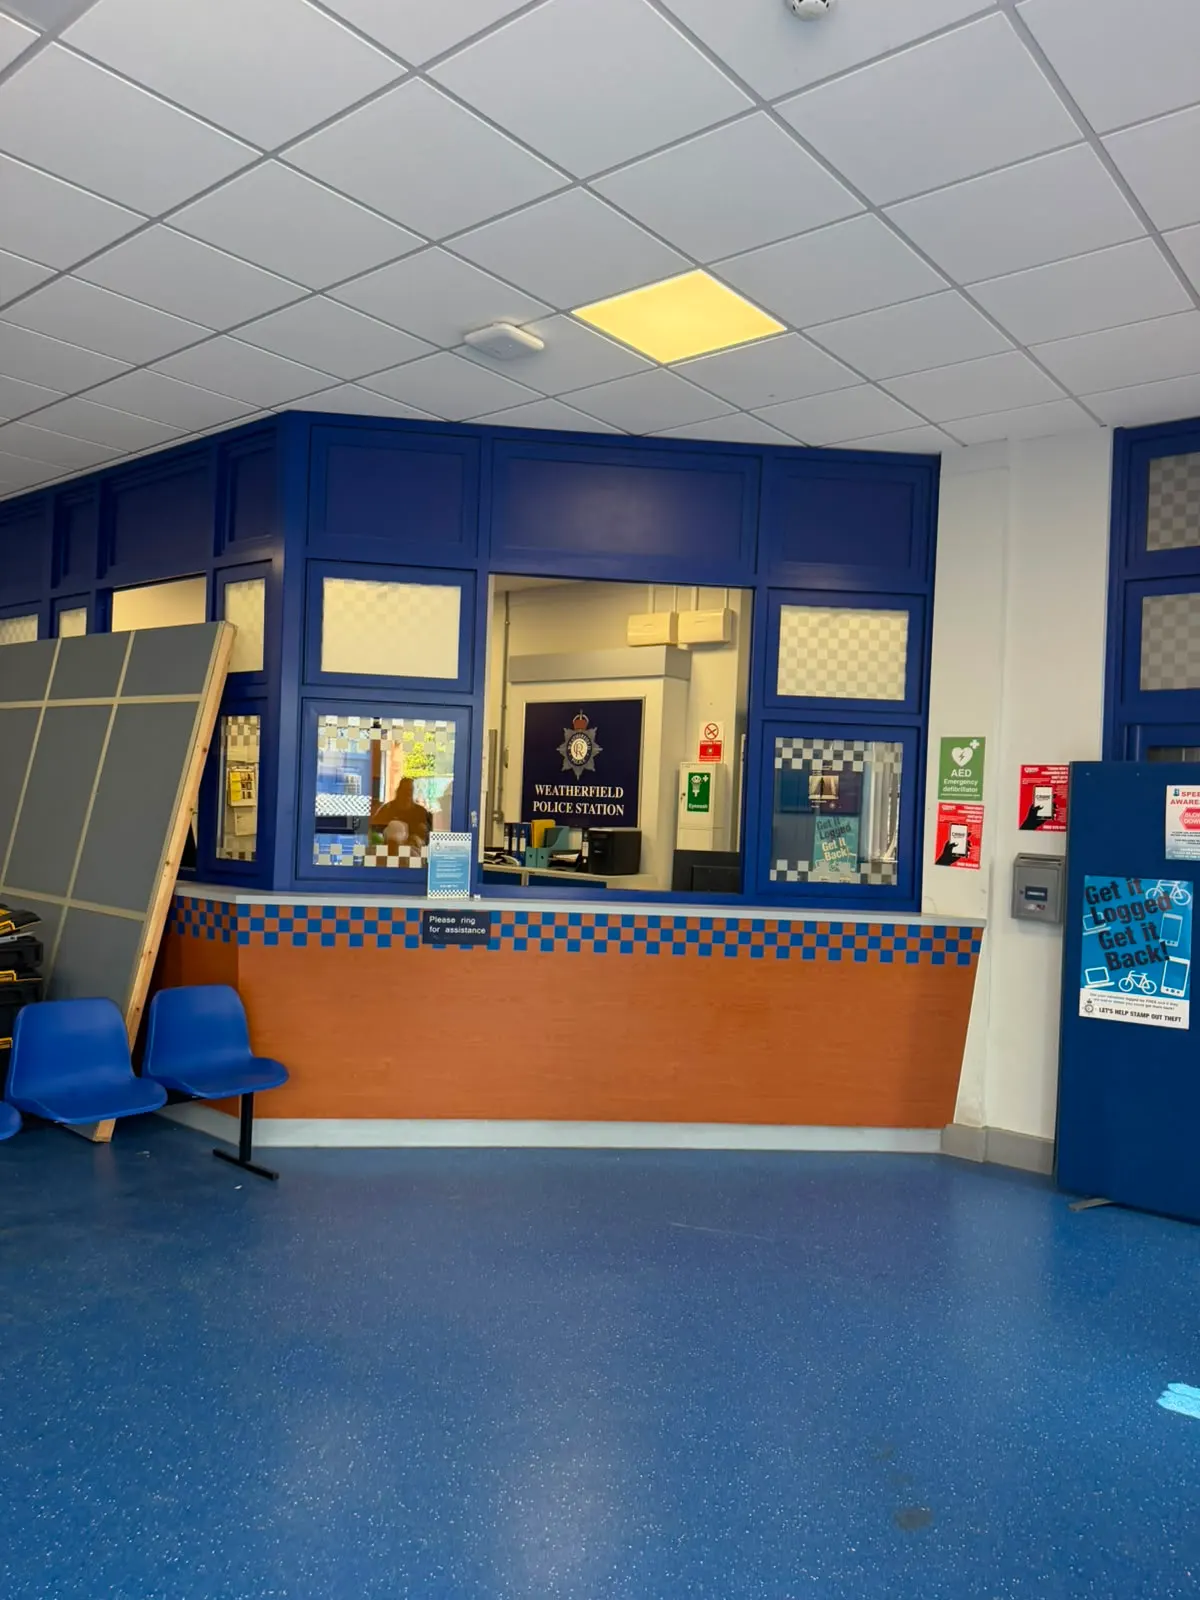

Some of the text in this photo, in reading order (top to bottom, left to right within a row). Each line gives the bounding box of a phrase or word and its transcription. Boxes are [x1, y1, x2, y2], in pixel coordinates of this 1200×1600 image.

[951, 769, 972, 777] AED
[944, 778, 978, 786] Emergency
[535, 784, 624, 799] WEATHERFIELD
[533, 800, 625, 817] POLICE STATION
[817, 819, 832, 831] Get
[819, 823, 852, 840] Logged
[822, 840, 837, 852] Get
[824, 847, 850, 862] Back!
[1085, 878, 1144, 906] Get it
[1090, 892, 1174, 926] Logged
[429, 916, 476, 925] Please ring
[429, 926, 486, 935] for assistance
[1097, 921, 1160, 950] Get it
[1104, 941, 1170, 971] Back!
[1130, 1011, 1150, 1019] STAMP
[1164, 1015, 1182, 1023] THEFT
